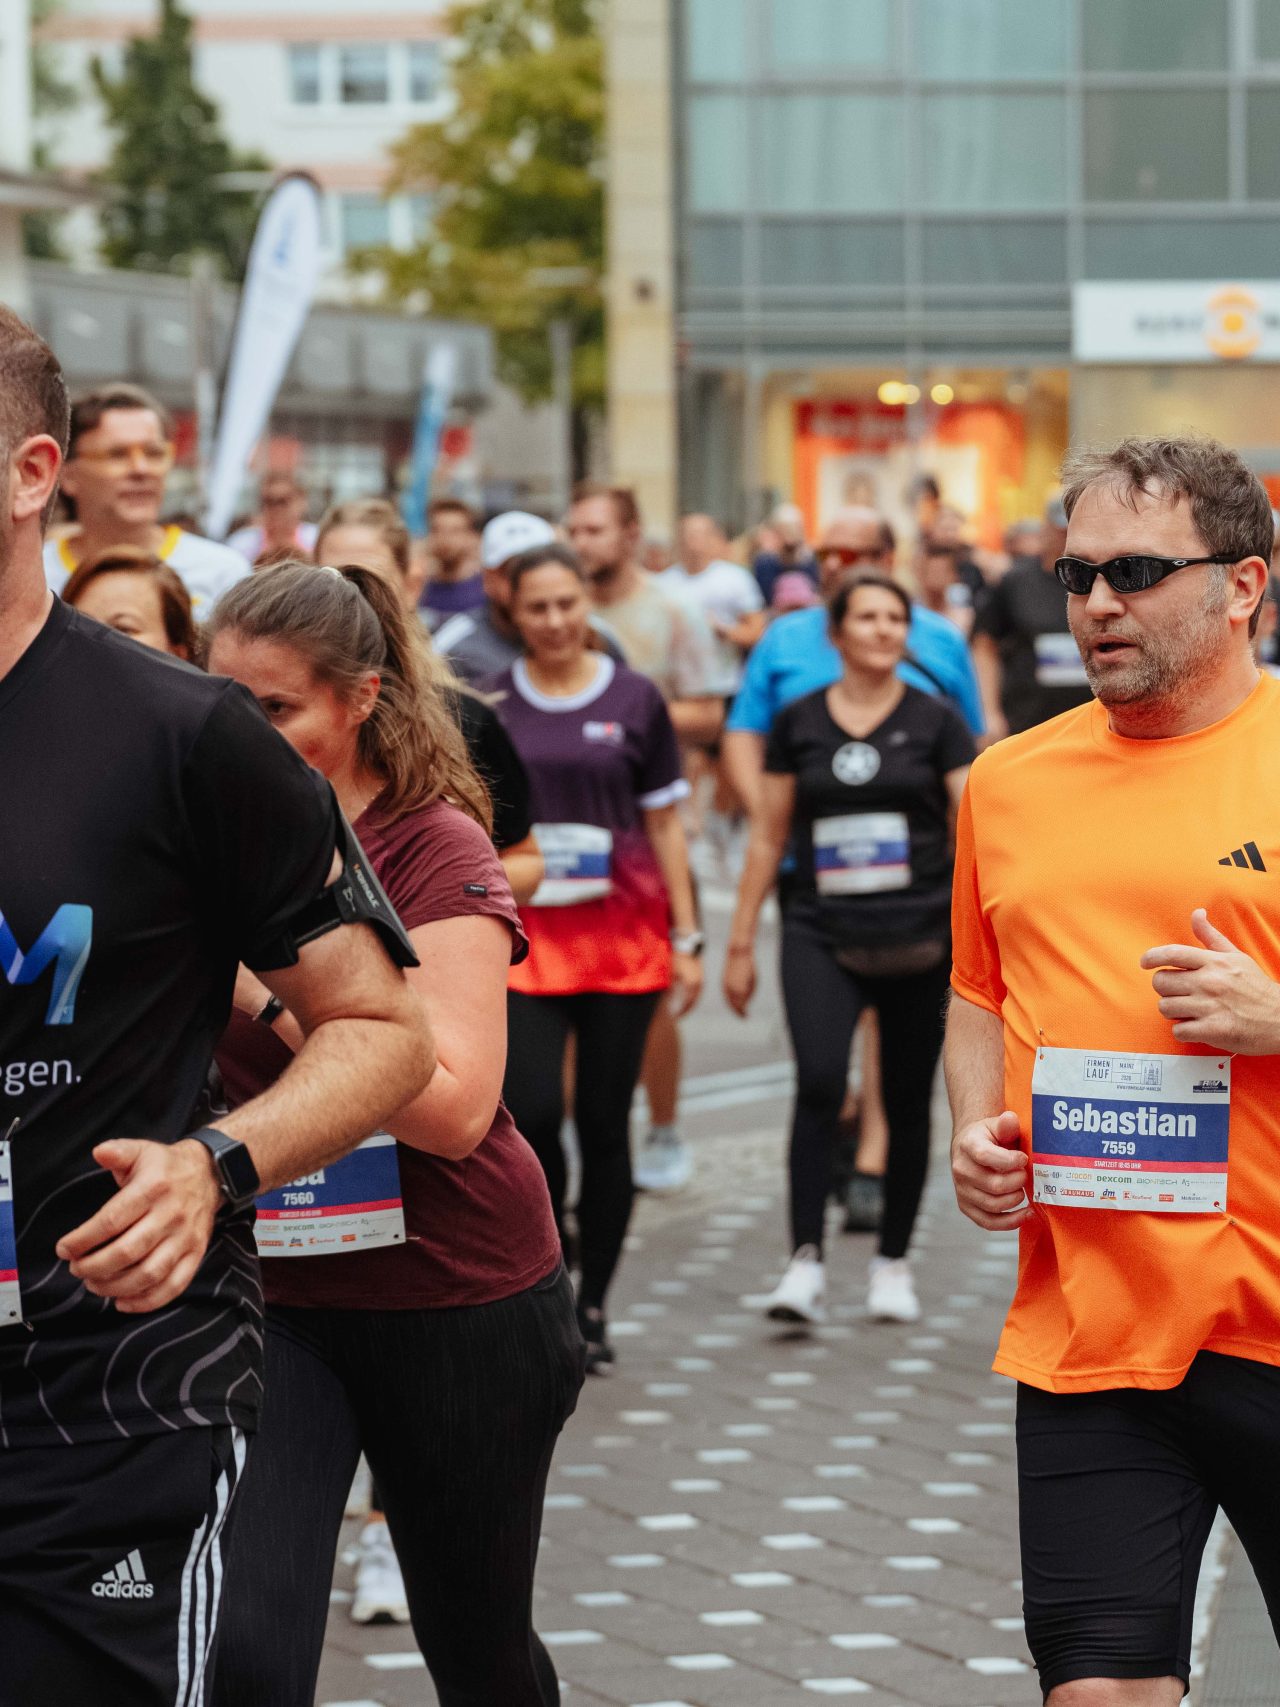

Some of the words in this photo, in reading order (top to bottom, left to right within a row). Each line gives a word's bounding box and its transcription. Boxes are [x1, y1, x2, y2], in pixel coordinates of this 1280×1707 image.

[1087, 1059, 1110, 1068] FIRMEN
[0, 1059, 81, 1096] gen.
[1086, 1068, 1110, 1079] LAUF
[1052, 1101, 1197, 1138] Sebastian
[1102, 1140, 1136, 1156] 7559
[1094, 1160, 1118, 1168] STARTZEIT
[282, 1191, 315, 1206] 7560
[1102, 1188, 1115, 1196] dm
[91, 1579, 154, 1599] adidas
